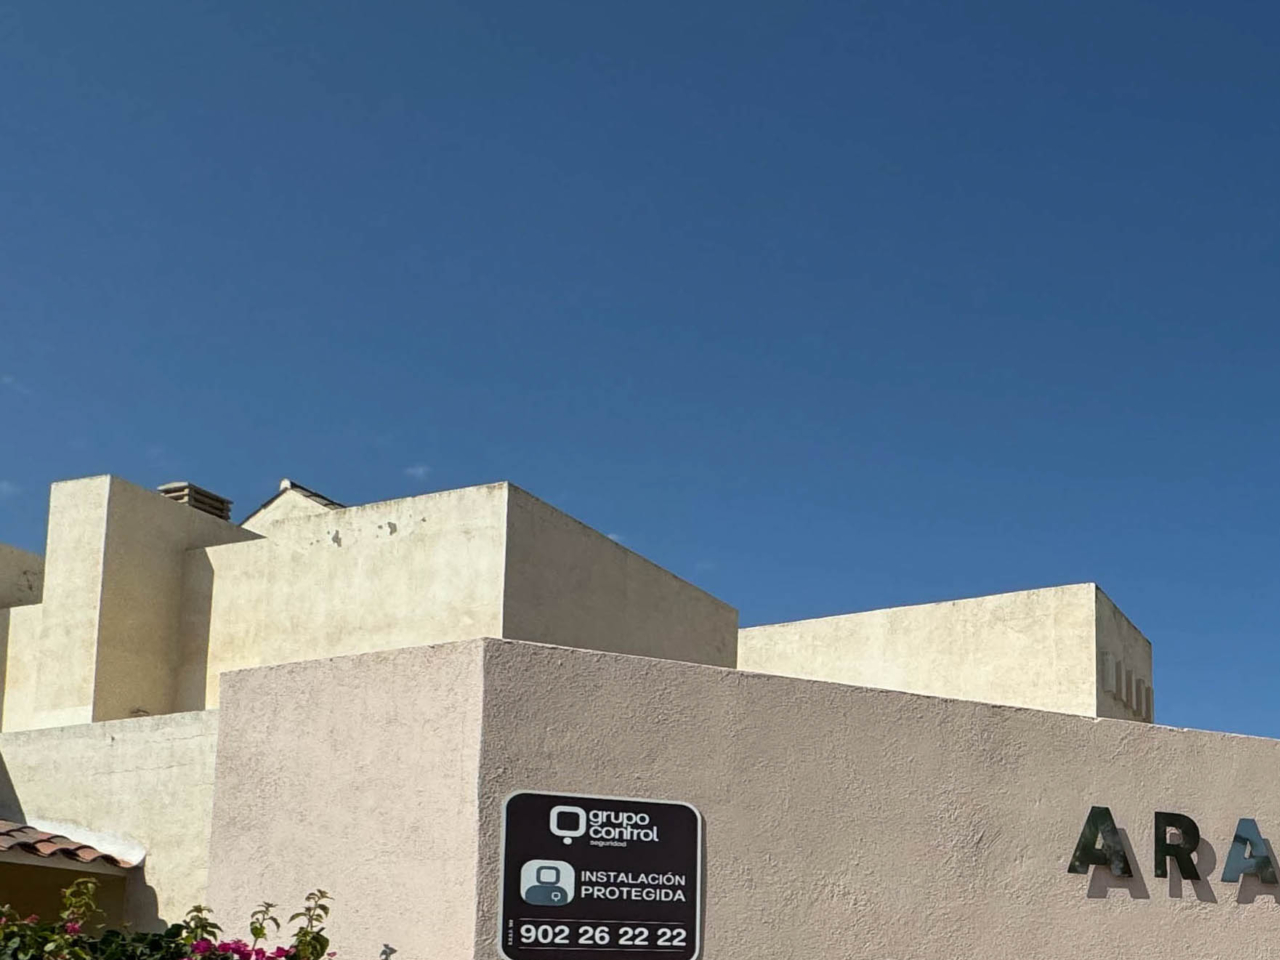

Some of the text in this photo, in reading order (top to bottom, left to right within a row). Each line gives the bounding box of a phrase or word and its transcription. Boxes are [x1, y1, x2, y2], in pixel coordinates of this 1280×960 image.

[589, 809, 650, 827] grupo
[589, 825, 659, 842] control
[581, 870, 686, 886] INSTALACIÓN
[581, 886, 686, 902] PROTEGIDA
[520, 924, 570, 944] 902
[578, 926, 610, 945] 26
[618, 927, 649, 945] 22
[656, 928, 687, 946] 22
